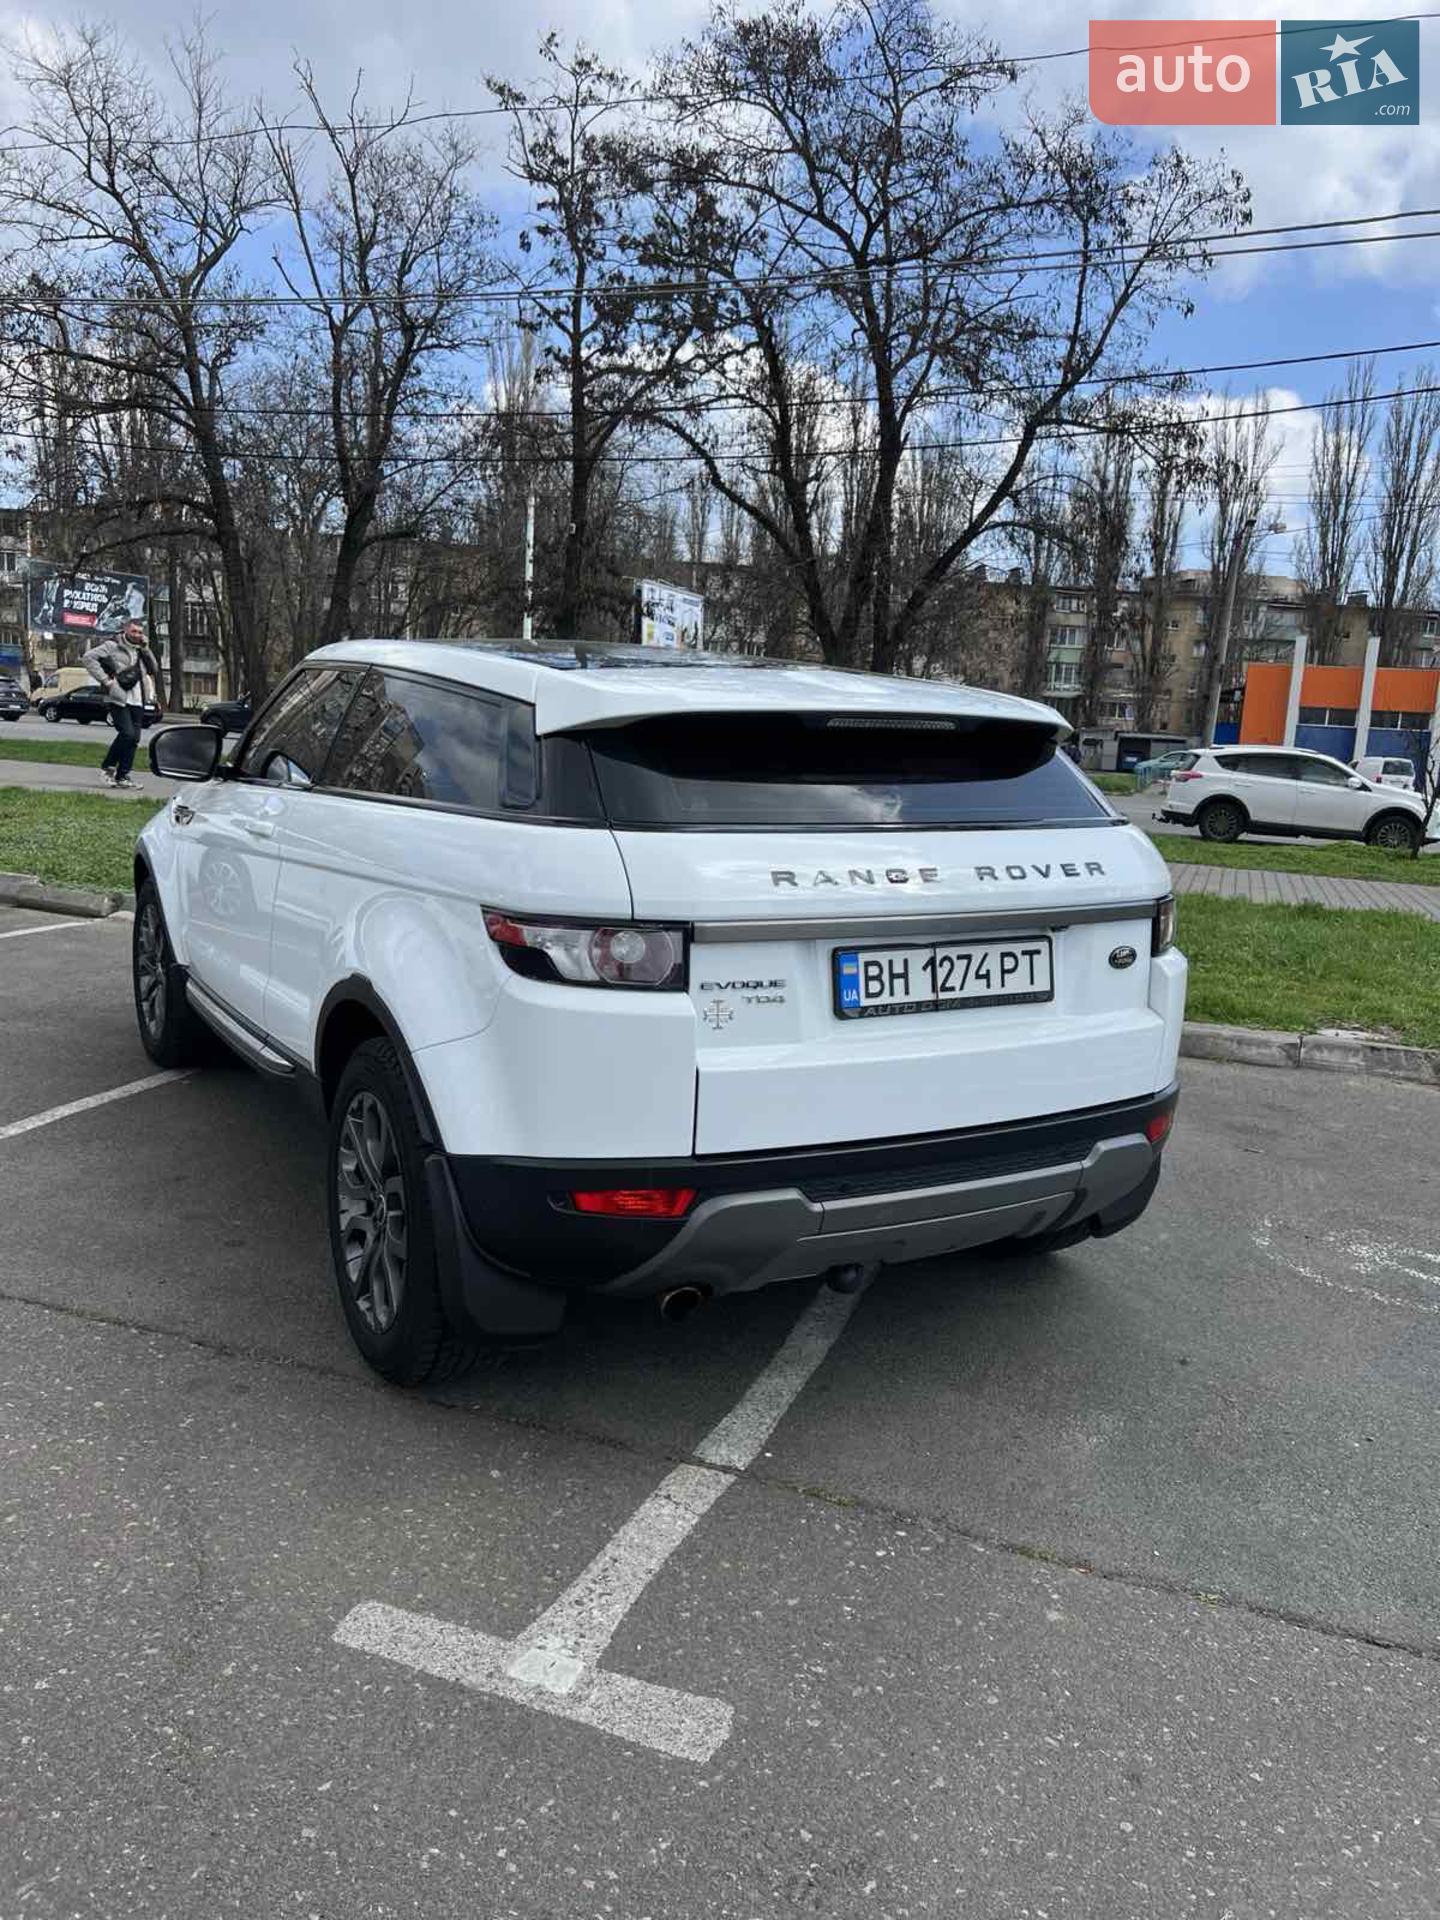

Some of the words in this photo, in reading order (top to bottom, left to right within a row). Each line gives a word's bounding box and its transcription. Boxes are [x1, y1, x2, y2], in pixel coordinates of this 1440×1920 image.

[770, 867, 942, 887] RANGE
[974, 862, 1106, 881] ROVER
[863, 957, 910, 999] BH
[921, 952, 991, 994] 1274
[999, 949, 1041, 988] PT
[700, 979, 786, 991] EVOQUE
[741, 994, 786, 1004] TD4
[843, 989, 859, 1001] UA
